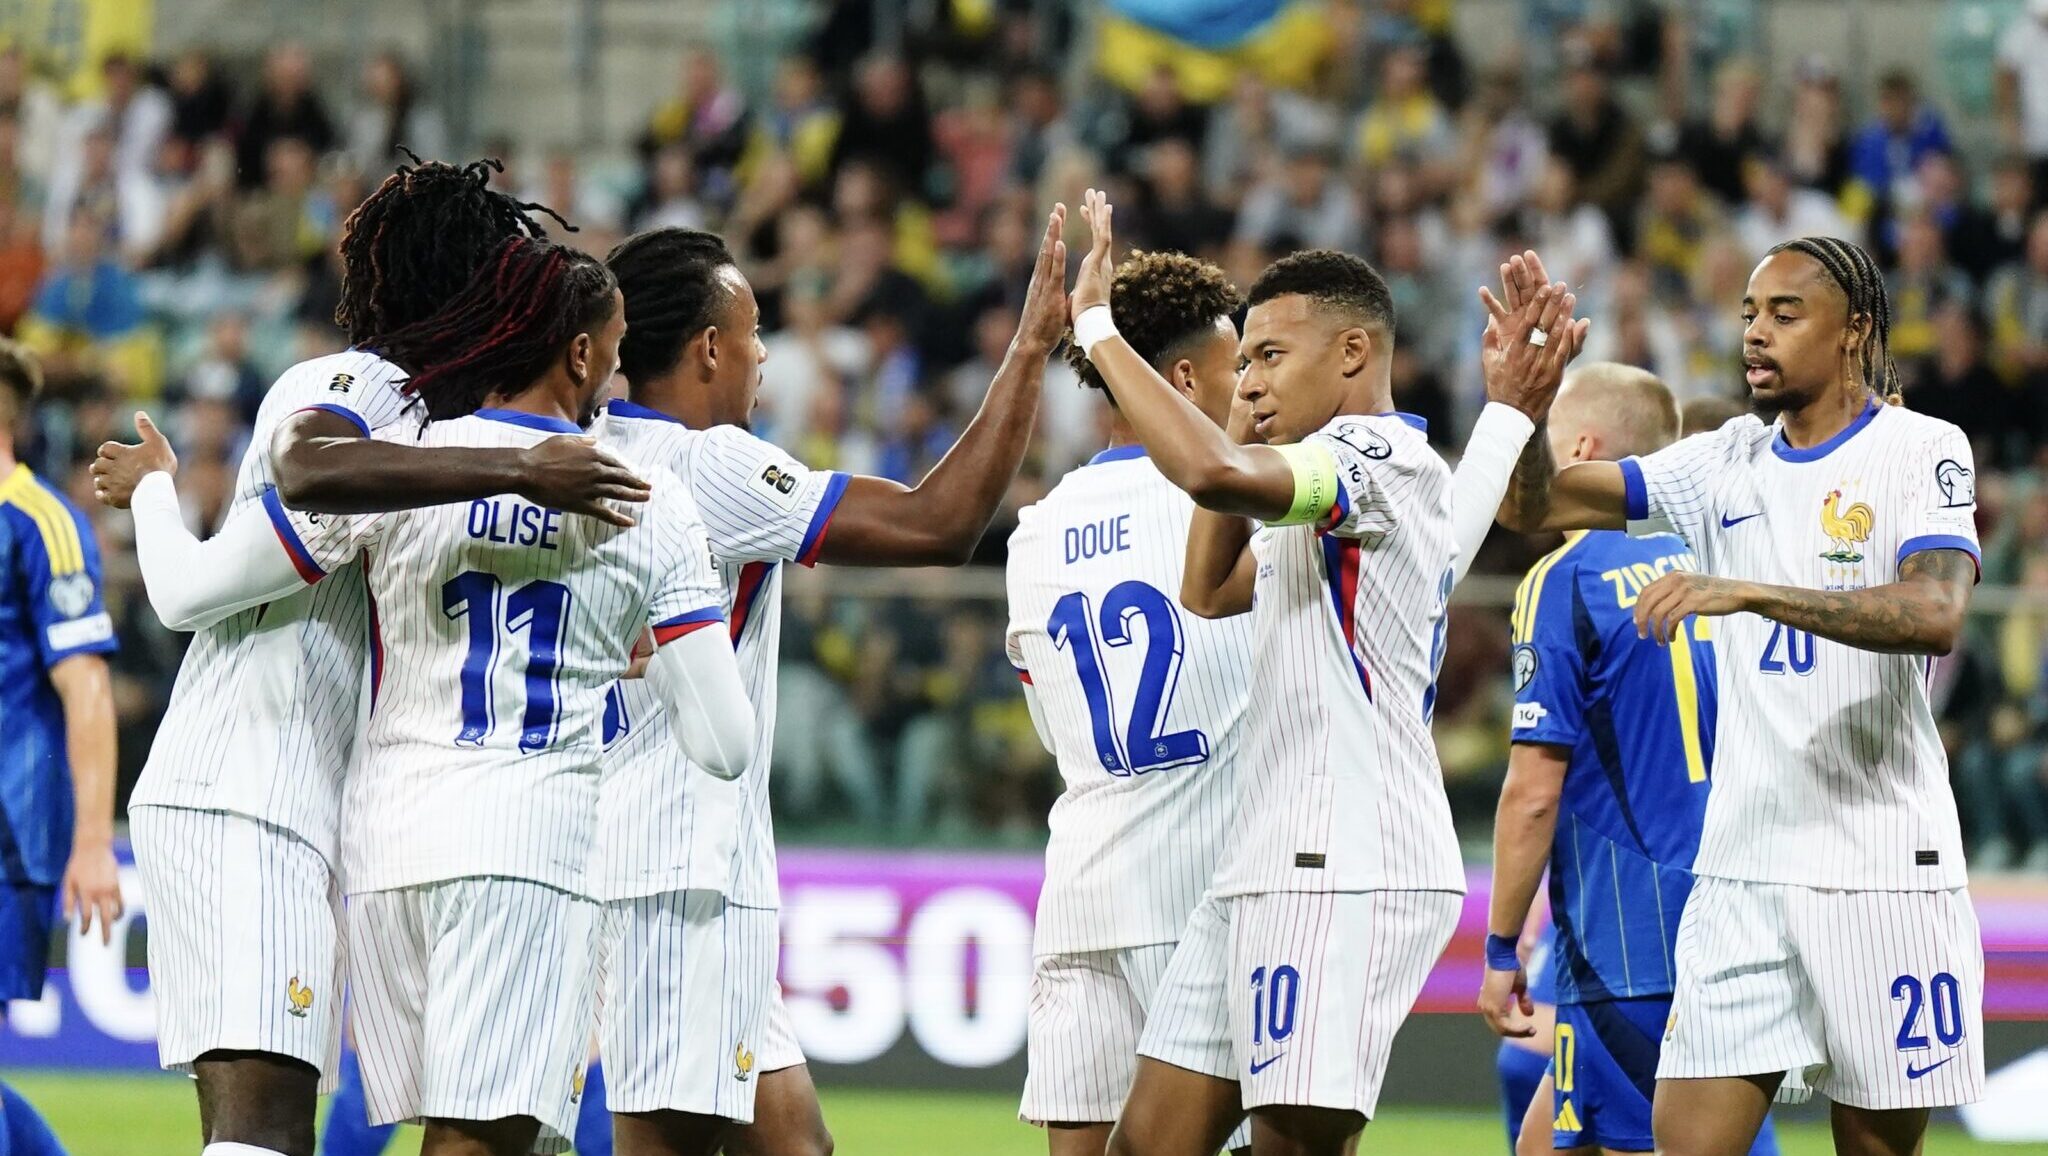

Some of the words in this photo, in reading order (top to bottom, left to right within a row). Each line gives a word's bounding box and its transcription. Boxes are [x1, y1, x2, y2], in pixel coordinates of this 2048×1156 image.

[467, 498, 562, 550] OLISE
[1064, 513, 1131, 565] DOUE
[441, 570, 573, 755] 11
[1046, 580, 1210, 777] 12
[1759, 616, 1818, 677] 20
[1250, 964, 1301, 1046] 10
[1890, 972, 1968, 1052] 20
